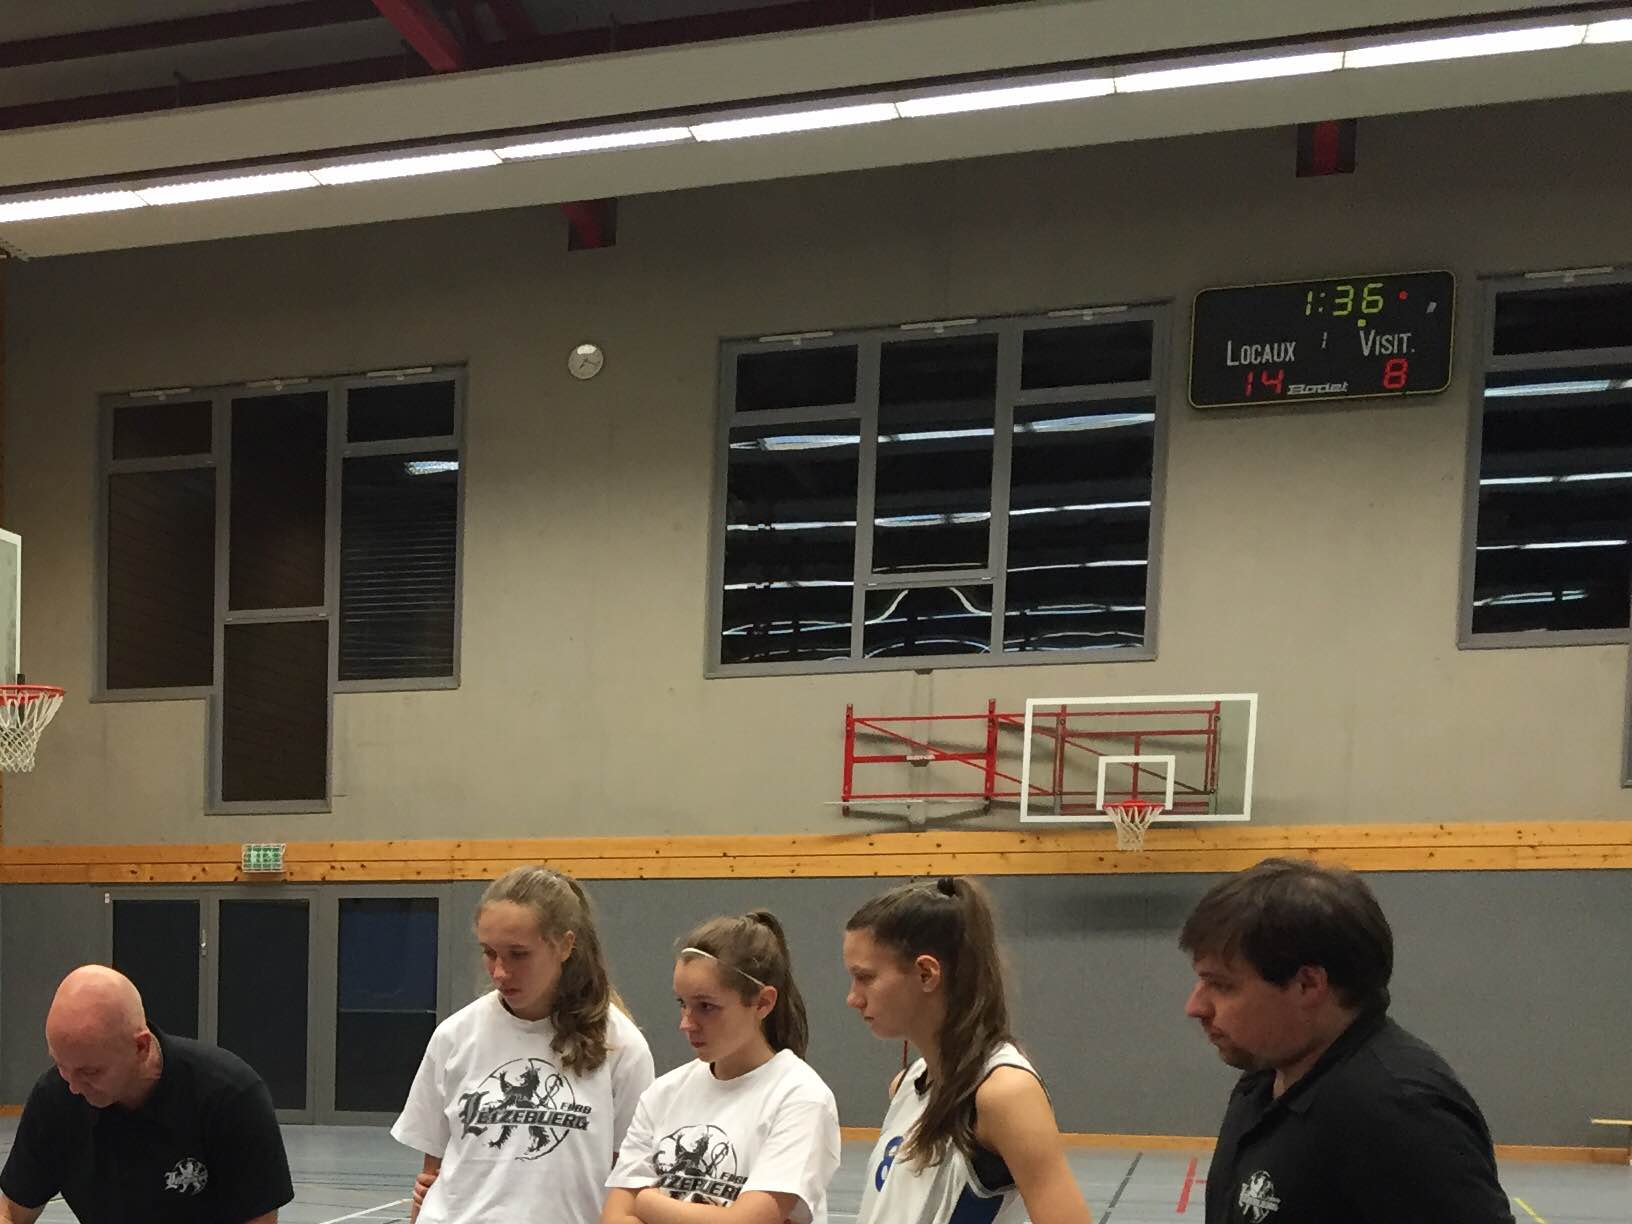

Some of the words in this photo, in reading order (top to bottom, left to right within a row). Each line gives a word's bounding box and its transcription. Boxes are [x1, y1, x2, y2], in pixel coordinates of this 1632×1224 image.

[1304, 283, 1384, 316] 1:36
[1244, 369, 1285, 396] 14
[1382, 357, 1409, 389] 8
